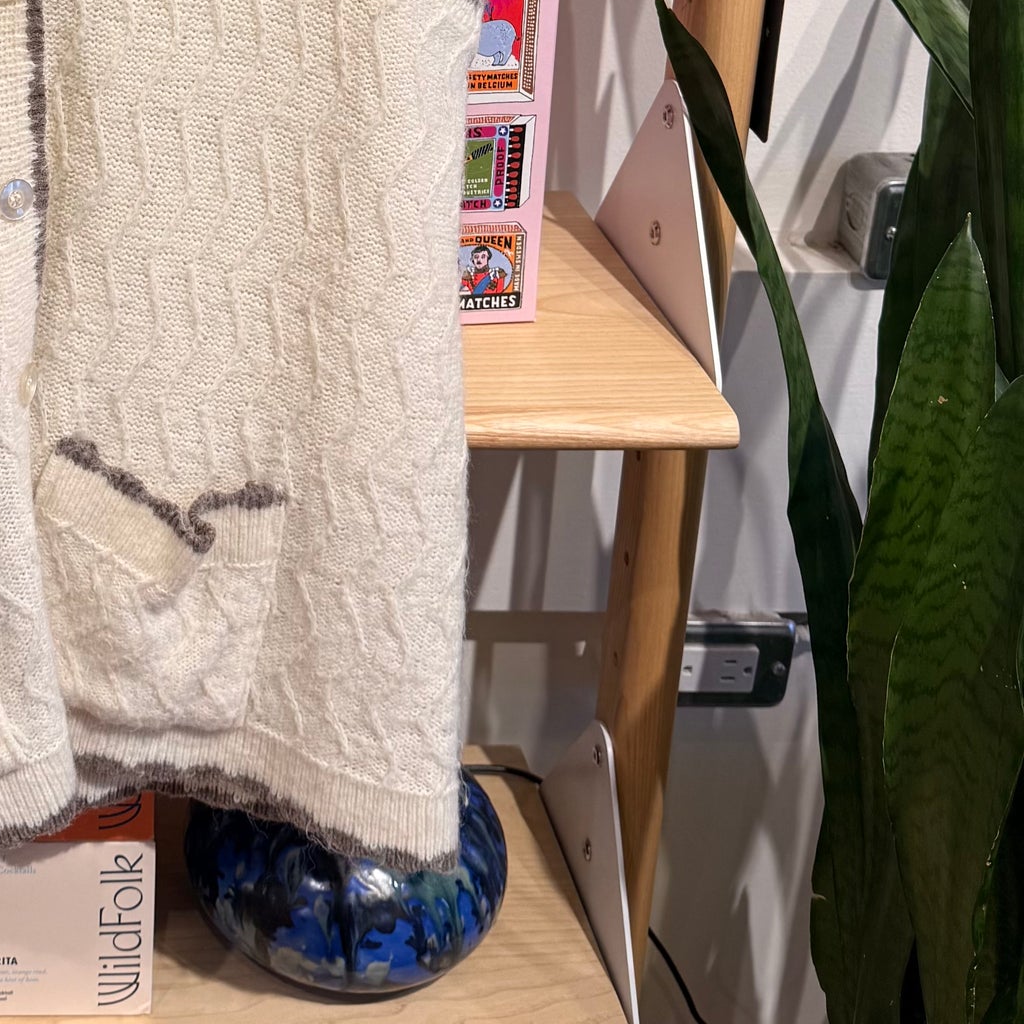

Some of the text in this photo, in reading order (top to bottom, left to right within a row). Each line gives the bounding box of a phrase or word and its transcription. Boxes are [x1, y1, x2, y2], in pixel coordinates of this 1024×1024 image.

[487, 72, 519, 80] MATCHES
[478, 81, 513, 89] BELGIUM
[495, 146, 505, 186] PROOF
[474, 235, 513, 249] QUEEN
[97, 852, 144, 1007] WildFolk
